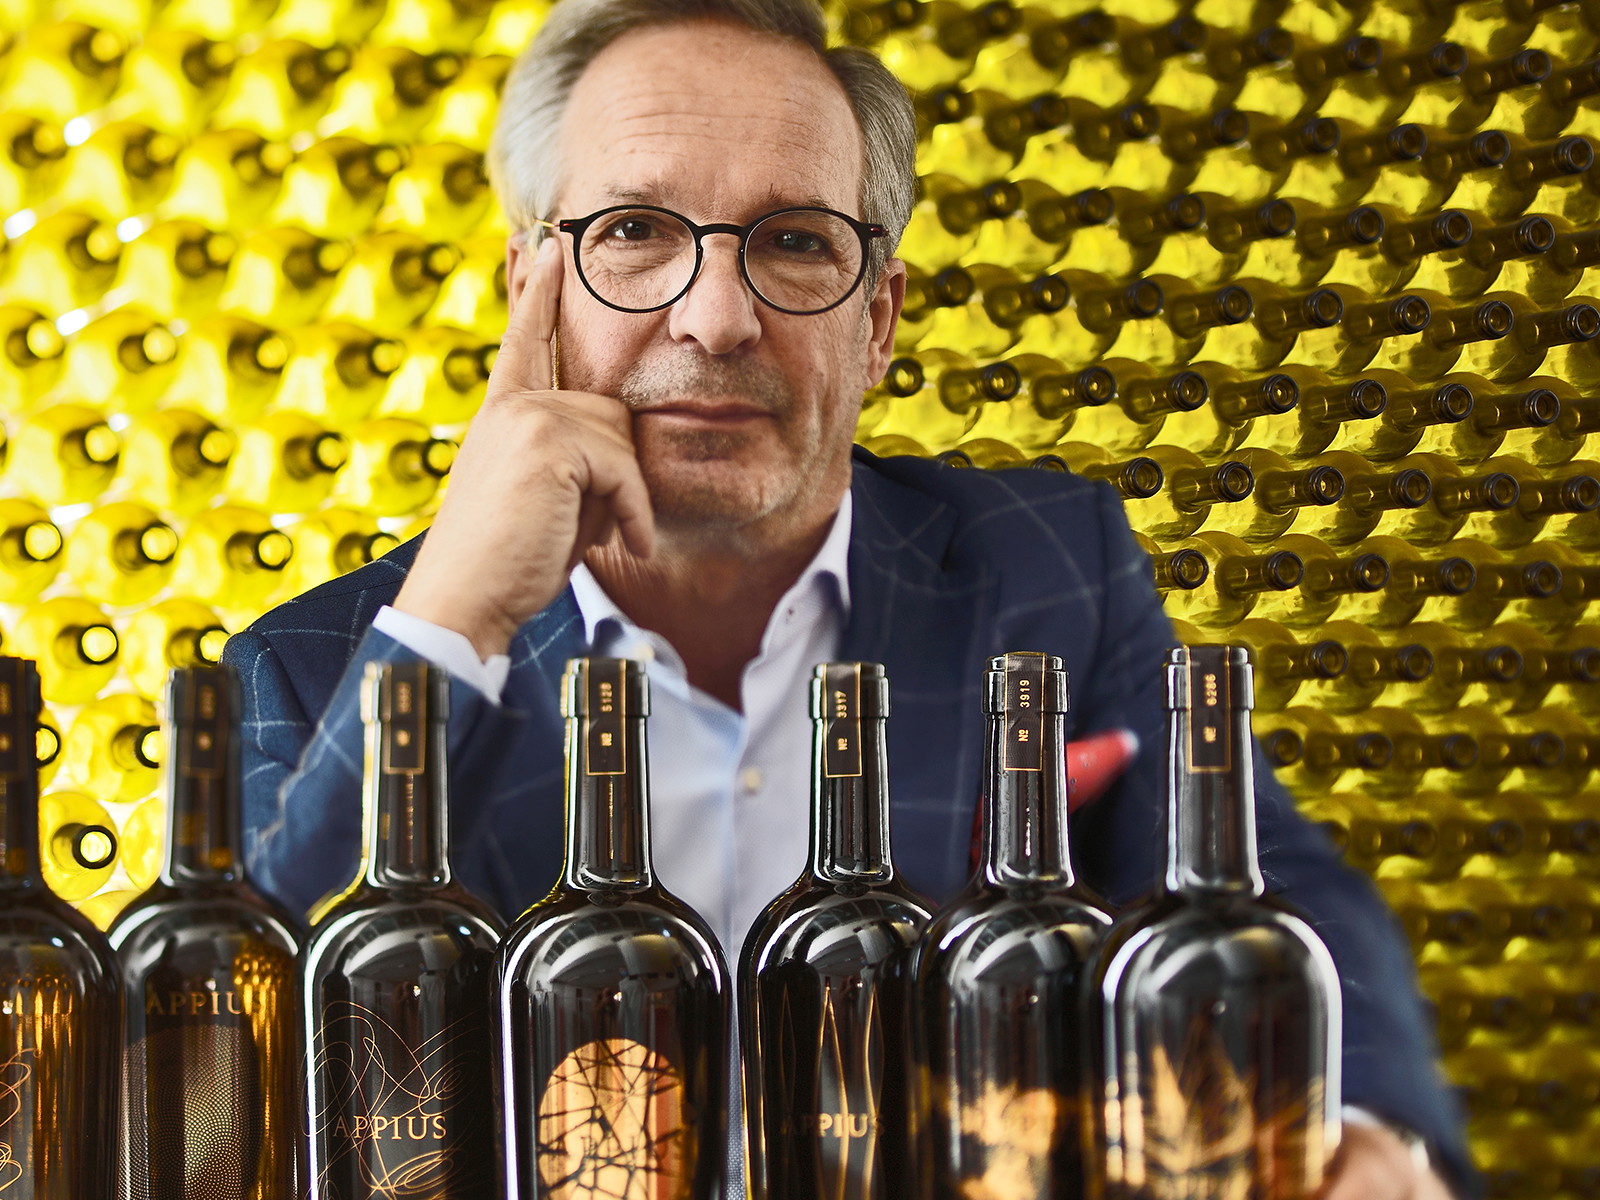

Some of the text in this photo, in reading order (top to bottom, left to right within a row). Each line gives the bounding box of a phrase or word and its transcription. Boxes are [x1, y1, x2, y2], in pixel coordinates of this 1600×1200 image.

[834, 690, 848, 718] 3317
[1019, 679, 1031, 708] 3919
[145, 990, 266, 1016] APPIUS
[332, 1115, 448, 1140] APPIUS
